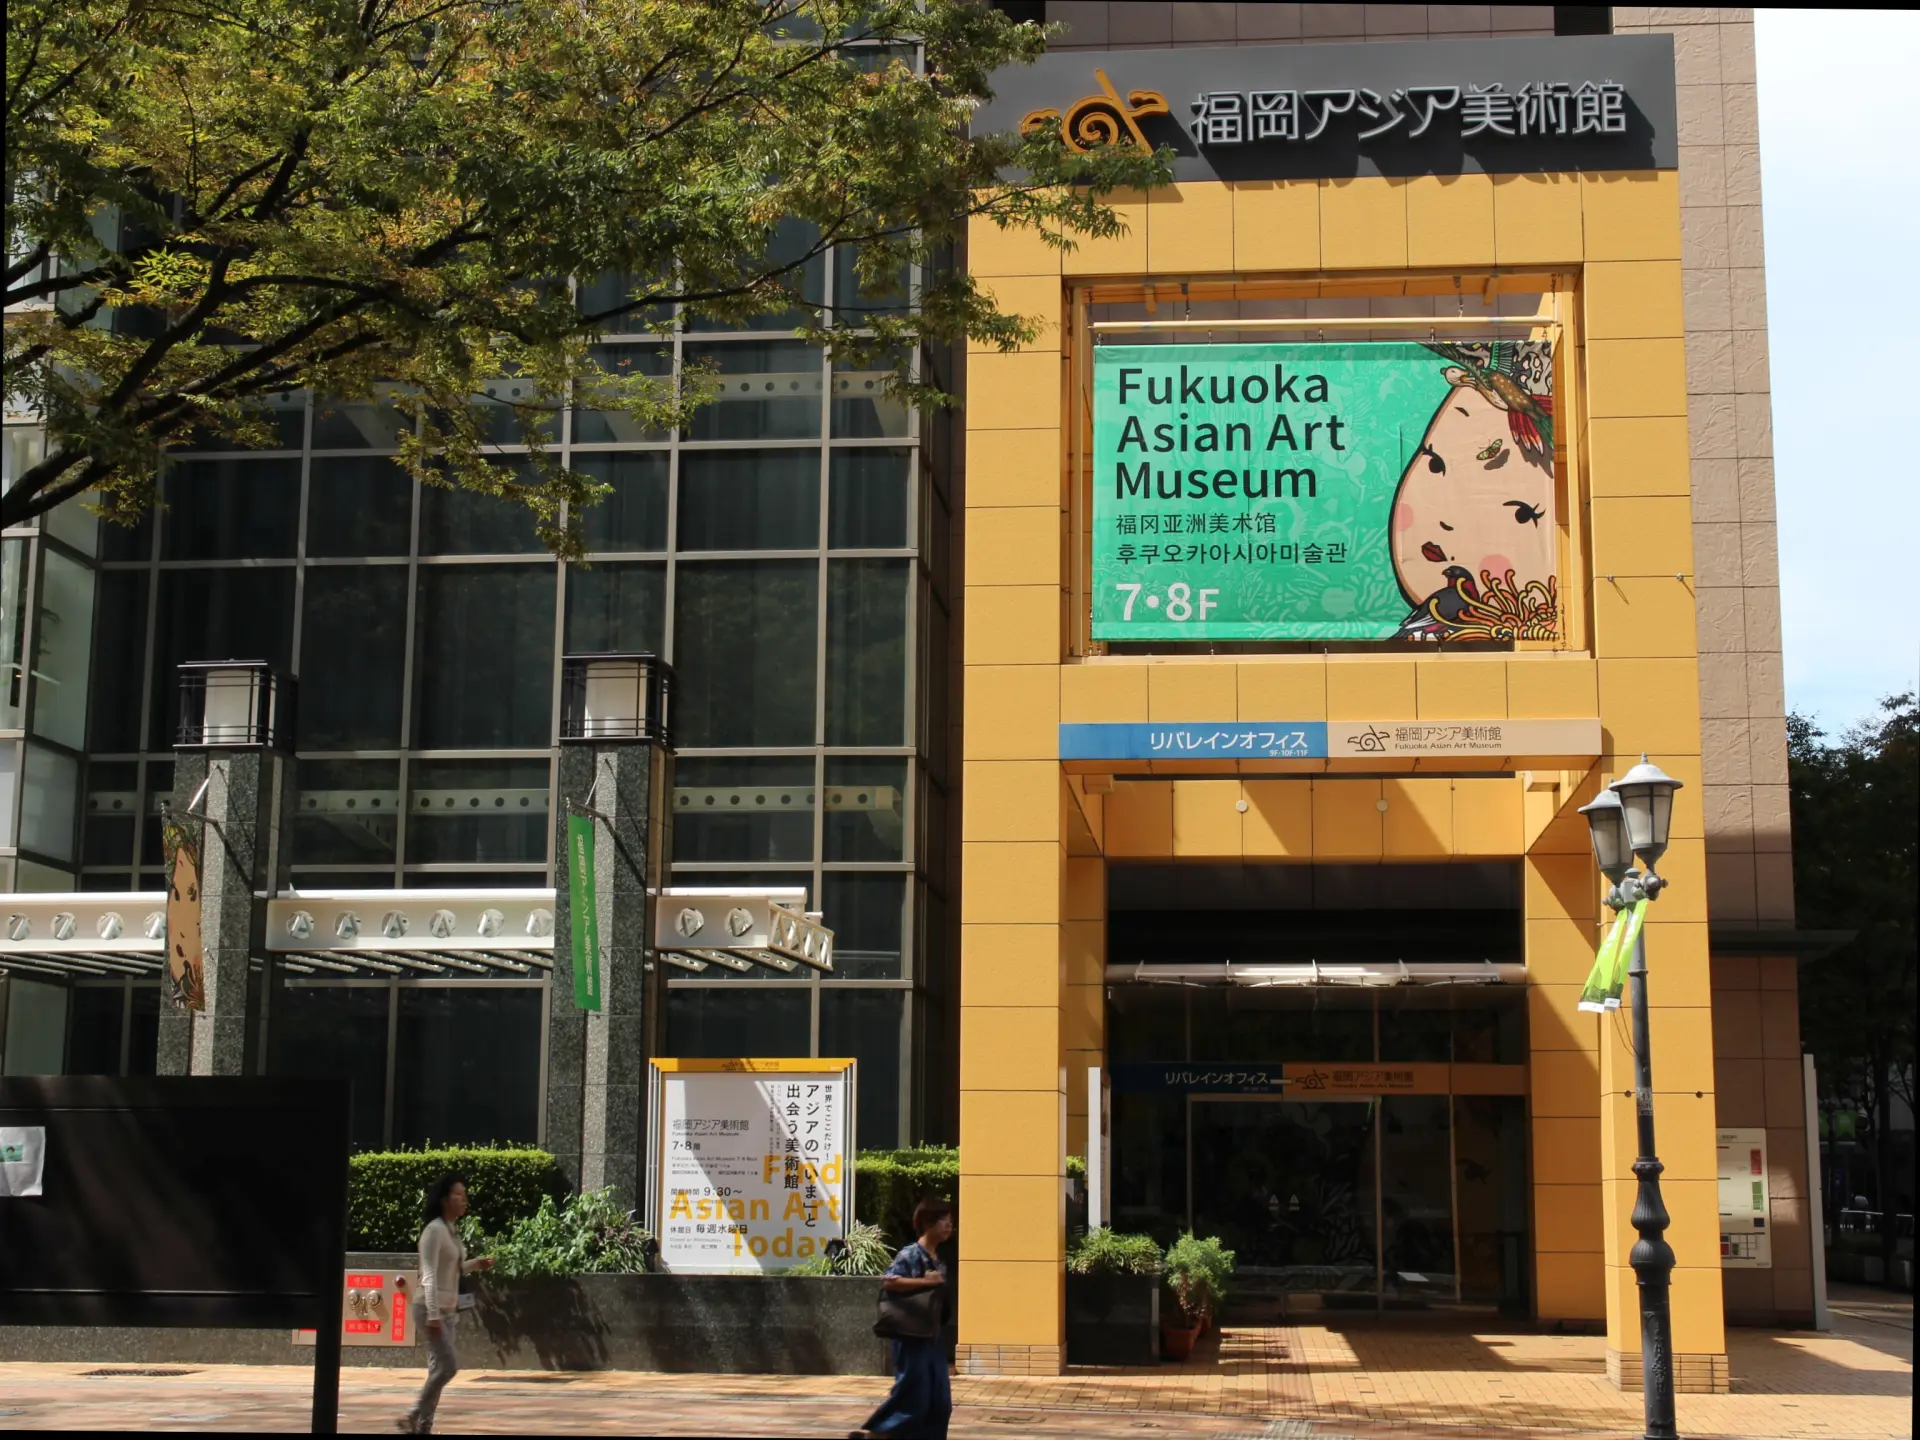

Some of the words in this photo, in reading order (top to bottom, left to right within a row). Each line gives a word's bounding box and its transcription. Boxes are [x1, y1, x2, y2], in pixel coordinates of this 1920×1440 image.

[1191, 80, 1627, 144] 福岡アジア美術館
[1118, 364, 1329, 405] Fukuoka
[1116, 412, 1252, 453] Asian
[1266, 413, 1346, 452] Art
[1116, 461, 1317, 500] Museum
[1115, 512, 1277, 535] 福冈亚洲美术馆
[1150, 731, 1309, 750] リバレインオフィス
[1394, 726, 1502, 742] 福岡アジア美術館
[1394, 742, 1428, 750] Fukuoka
[1469, 741, 1502, 749] Museum
[1165, 1072, 1269, 1085] リバレインオフィス
[783, 1083, 801, 1189] 出会う美術館
[669, 1190, 770, 1221] Asian
[782, 1190, 842, 1222] Art
